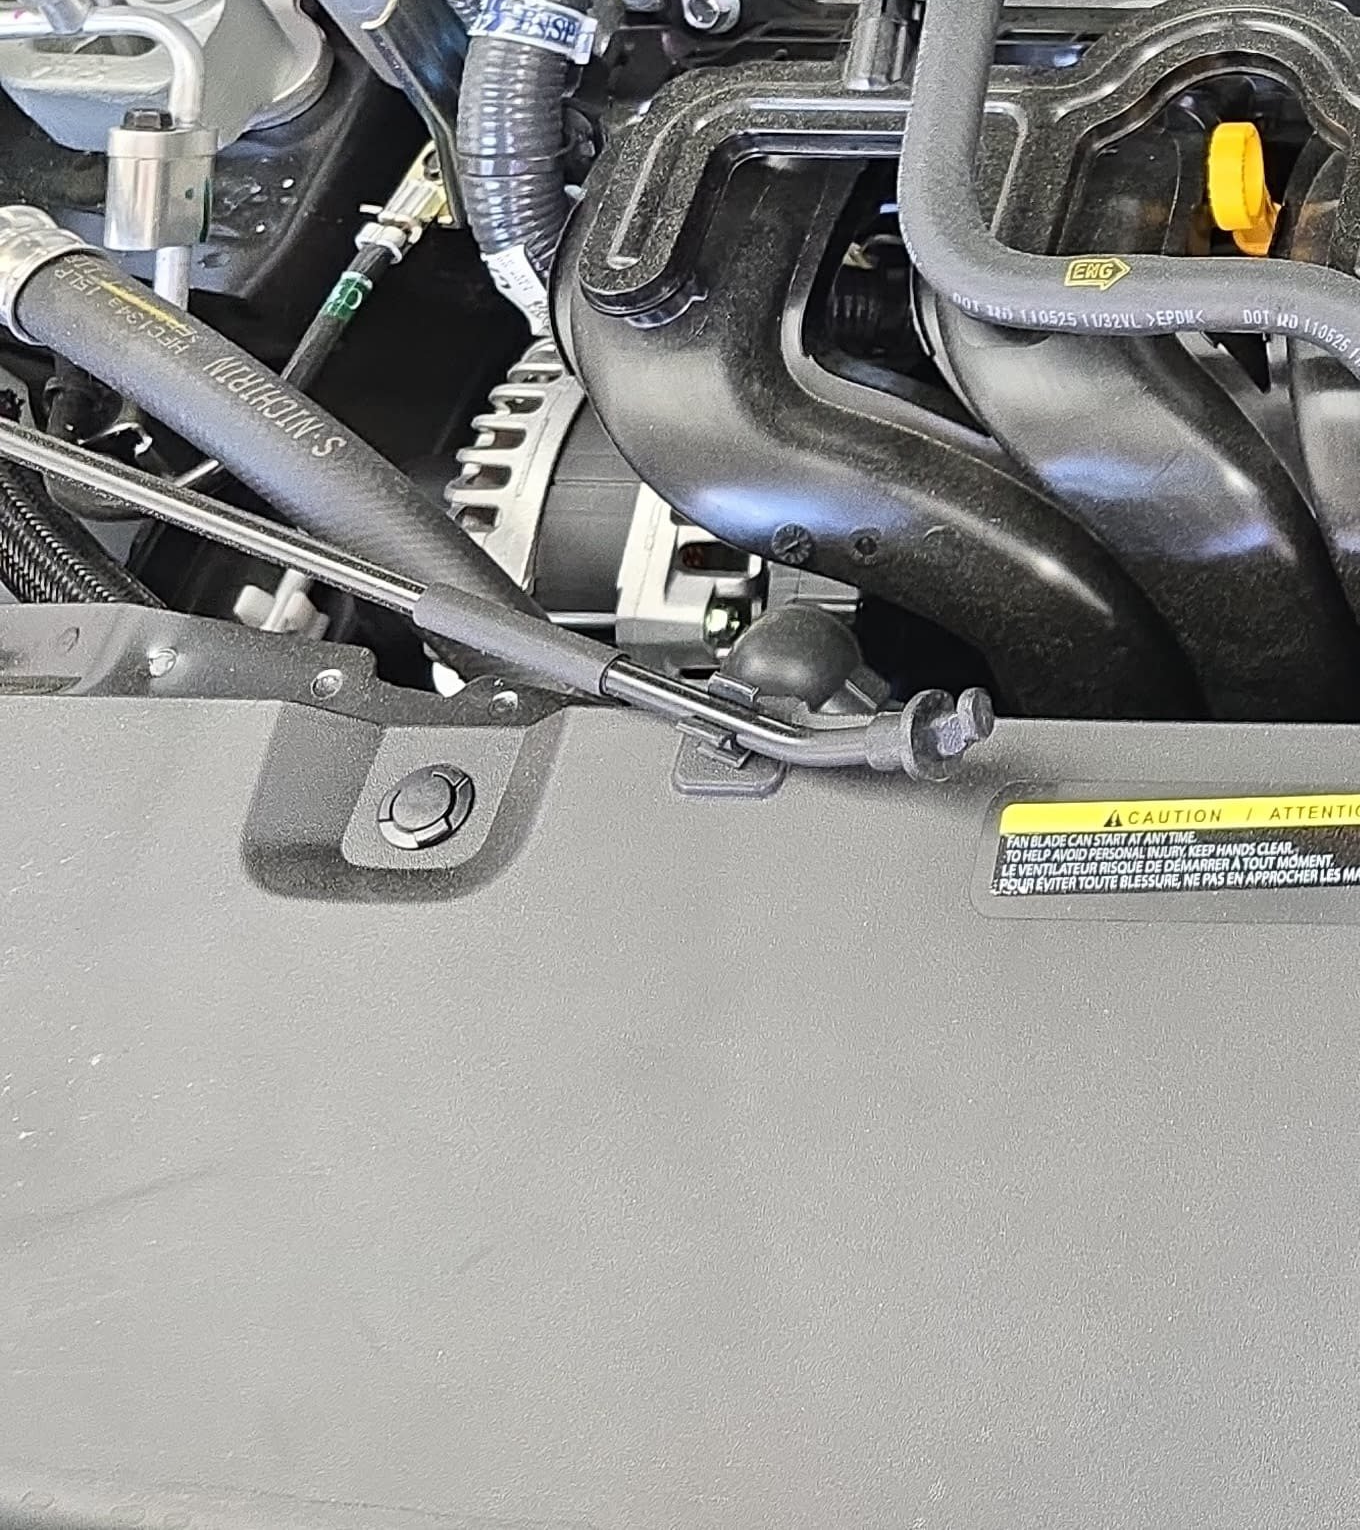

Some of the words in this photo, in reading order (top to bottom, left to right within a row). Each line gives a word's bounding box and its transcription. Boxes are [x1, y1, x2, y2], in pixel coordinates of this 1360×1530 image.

[1072, 262, 1114, 280] ENG
[1243, 309, 1270, 325] DOT
[1127, 808, 1222, 826] CAUTION
[1006, 835, 1029, 848] FAN
[1030, 834, 1067, 847] BLADE
[1067, 833, 1092, 846] CAN
[1093, 832, 1127, 845] START
[1128, 832, 1143, 844] AT
[1143, 832, 1168, 844] ANY
[1169, 831, 1198, 844] TIME.
[1005, 849, 1022, 863] TO
[1022, 849, 1051, 862] HELP
[1052, 847, 1087, 861] AVOID
[1088, 846, 1145, 860] PERSONAL
[1188, 844, 1215, 857] KEEP
[1216, 843, 1256, 857] HANDS
[1257, 842, 1294, 855] CLEAR.
[1002, 863, 1017, 876] LE
[1018, 860, 1098, 875] VENTILATEUR
[1099, 859, 1144, 873] RISQUE
[1145, 859, 1162, 872] DE
[1242, 856, 1275, 869] TOUT
[1276, 854, 1334, 868] MOMENT.
[999, 877, 1034, 892] POUR
[1078, 876, 1119, 890] TOUTE
[1119, 873, 1182, 889] BLESSURE,
[1183, 873, 1201, 887] NE
[1202, 872, 1225, 886] PAS
[1226, 871, 1244, 885] EN
[1245, 869, 1317, 885] APPROCHER
[1319, 869, 1342, 882] LES
